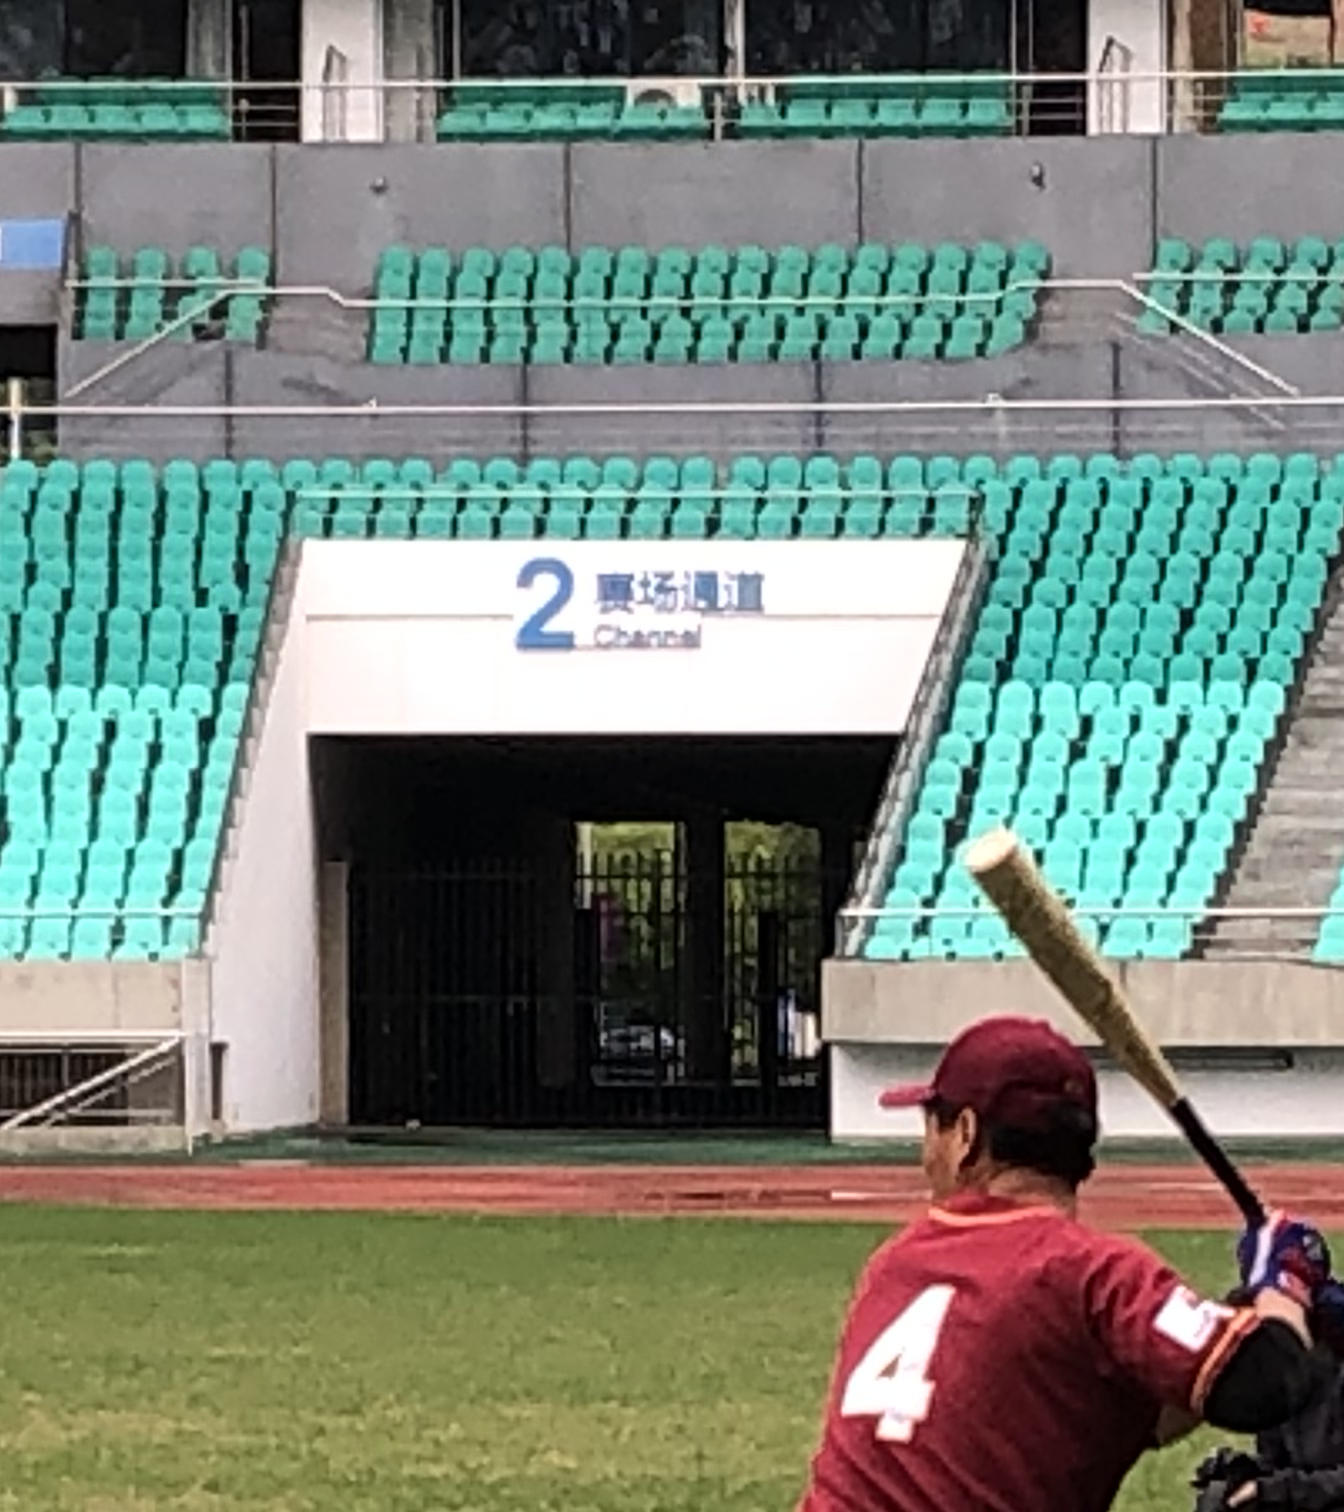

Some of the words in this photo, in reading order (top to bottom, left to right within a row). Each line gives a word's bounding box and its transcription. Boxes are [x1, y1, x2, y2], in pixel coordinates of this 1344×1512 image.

[515, 556, 576, 652] 2
[594, 624, 702, 649] Channel
[840, 1283, 956, 1443] 4
